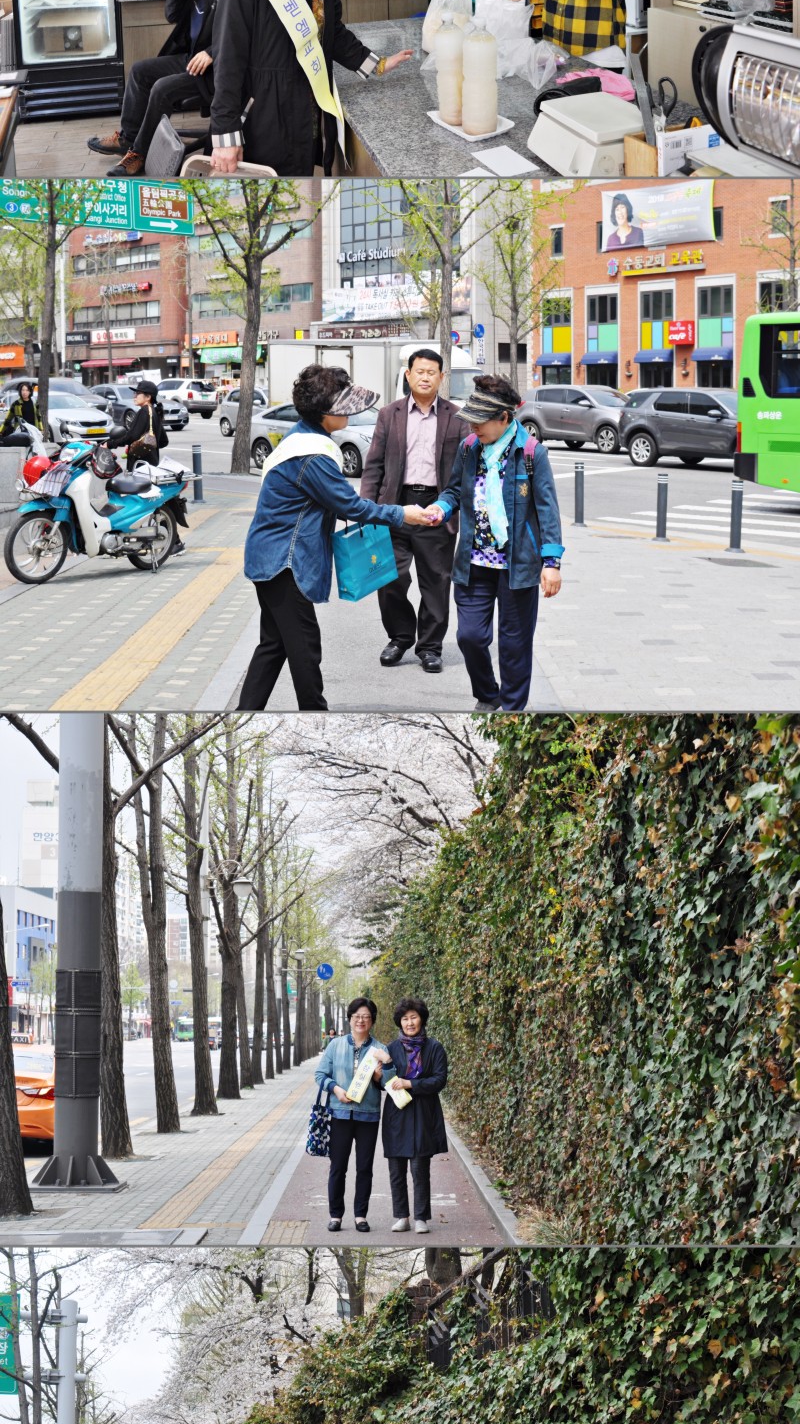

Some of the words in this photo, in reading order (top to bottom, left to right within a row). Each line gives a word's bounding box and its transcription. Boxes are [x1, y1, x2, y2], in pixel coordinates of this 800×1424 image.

[141, 185, 187, 201] 올림픽공원
[142, 207, 165, 218] Olympic
[168, 209, 181, 218] Park
[105, 216, 128, 225] Junction
[346, 249, 367, 263] Café
